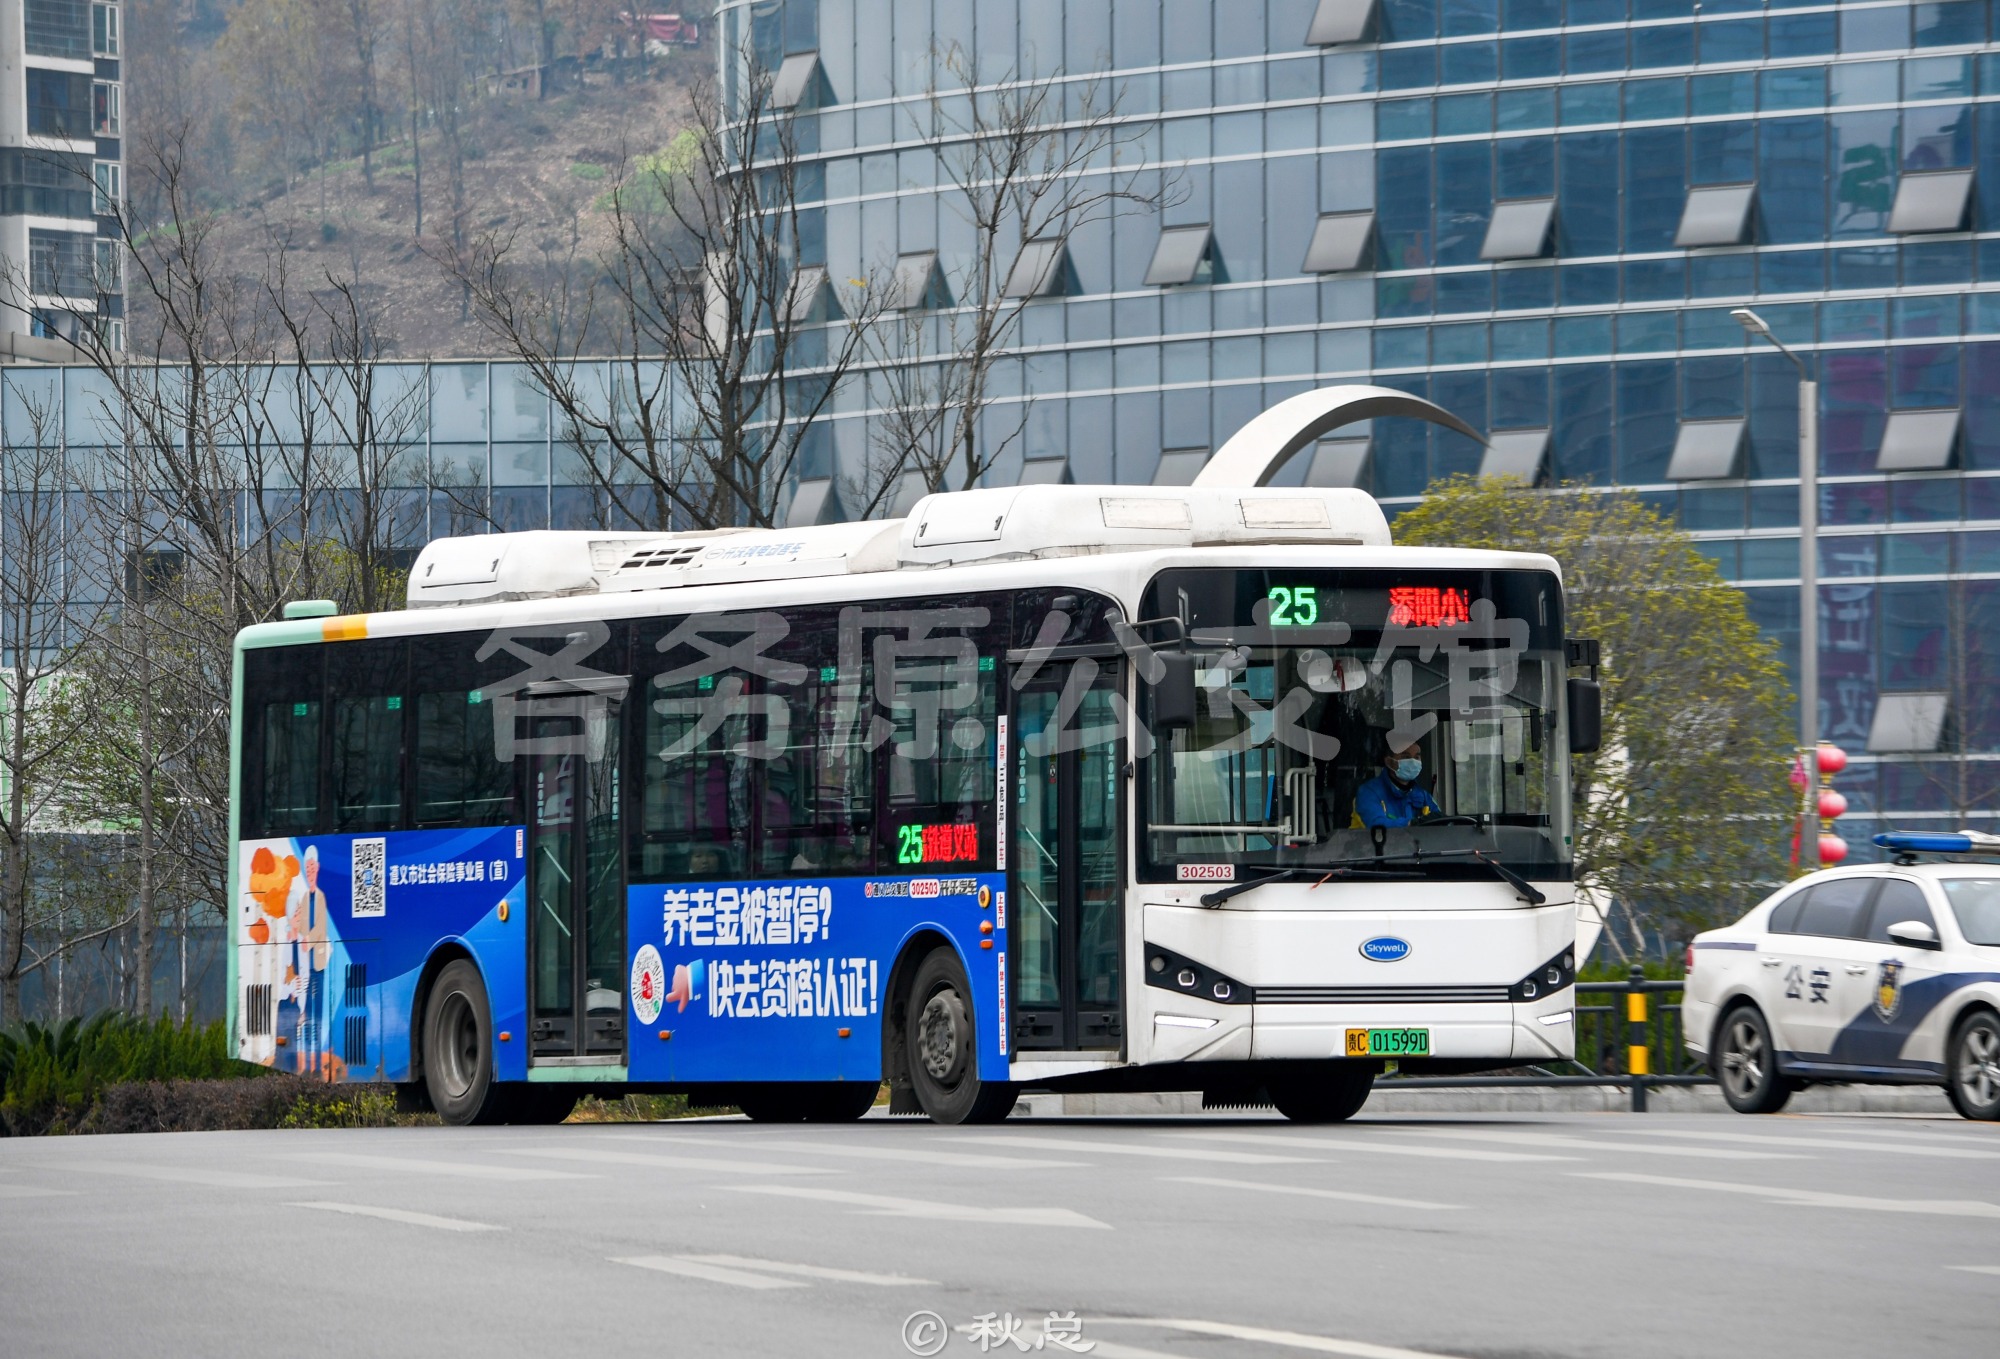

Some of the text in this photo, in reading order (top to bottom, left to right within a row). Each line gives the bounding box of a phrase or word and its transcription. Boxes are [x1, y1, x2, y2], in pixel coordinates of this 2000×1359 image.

[1269, 587, 1317, 626] 25
[898, 825, 923, 864] 25
[911, 882, 938, 896] 302503
[1181, 866, 1232, 878] 302503
[663, 886, 833, 947] 养老金被暂停?
[1366, 943, 1406, 953] Skywell
[708, 957, 879, 1018] 快去资格认证!
[1784, 965, 1830, 1004] 公安
